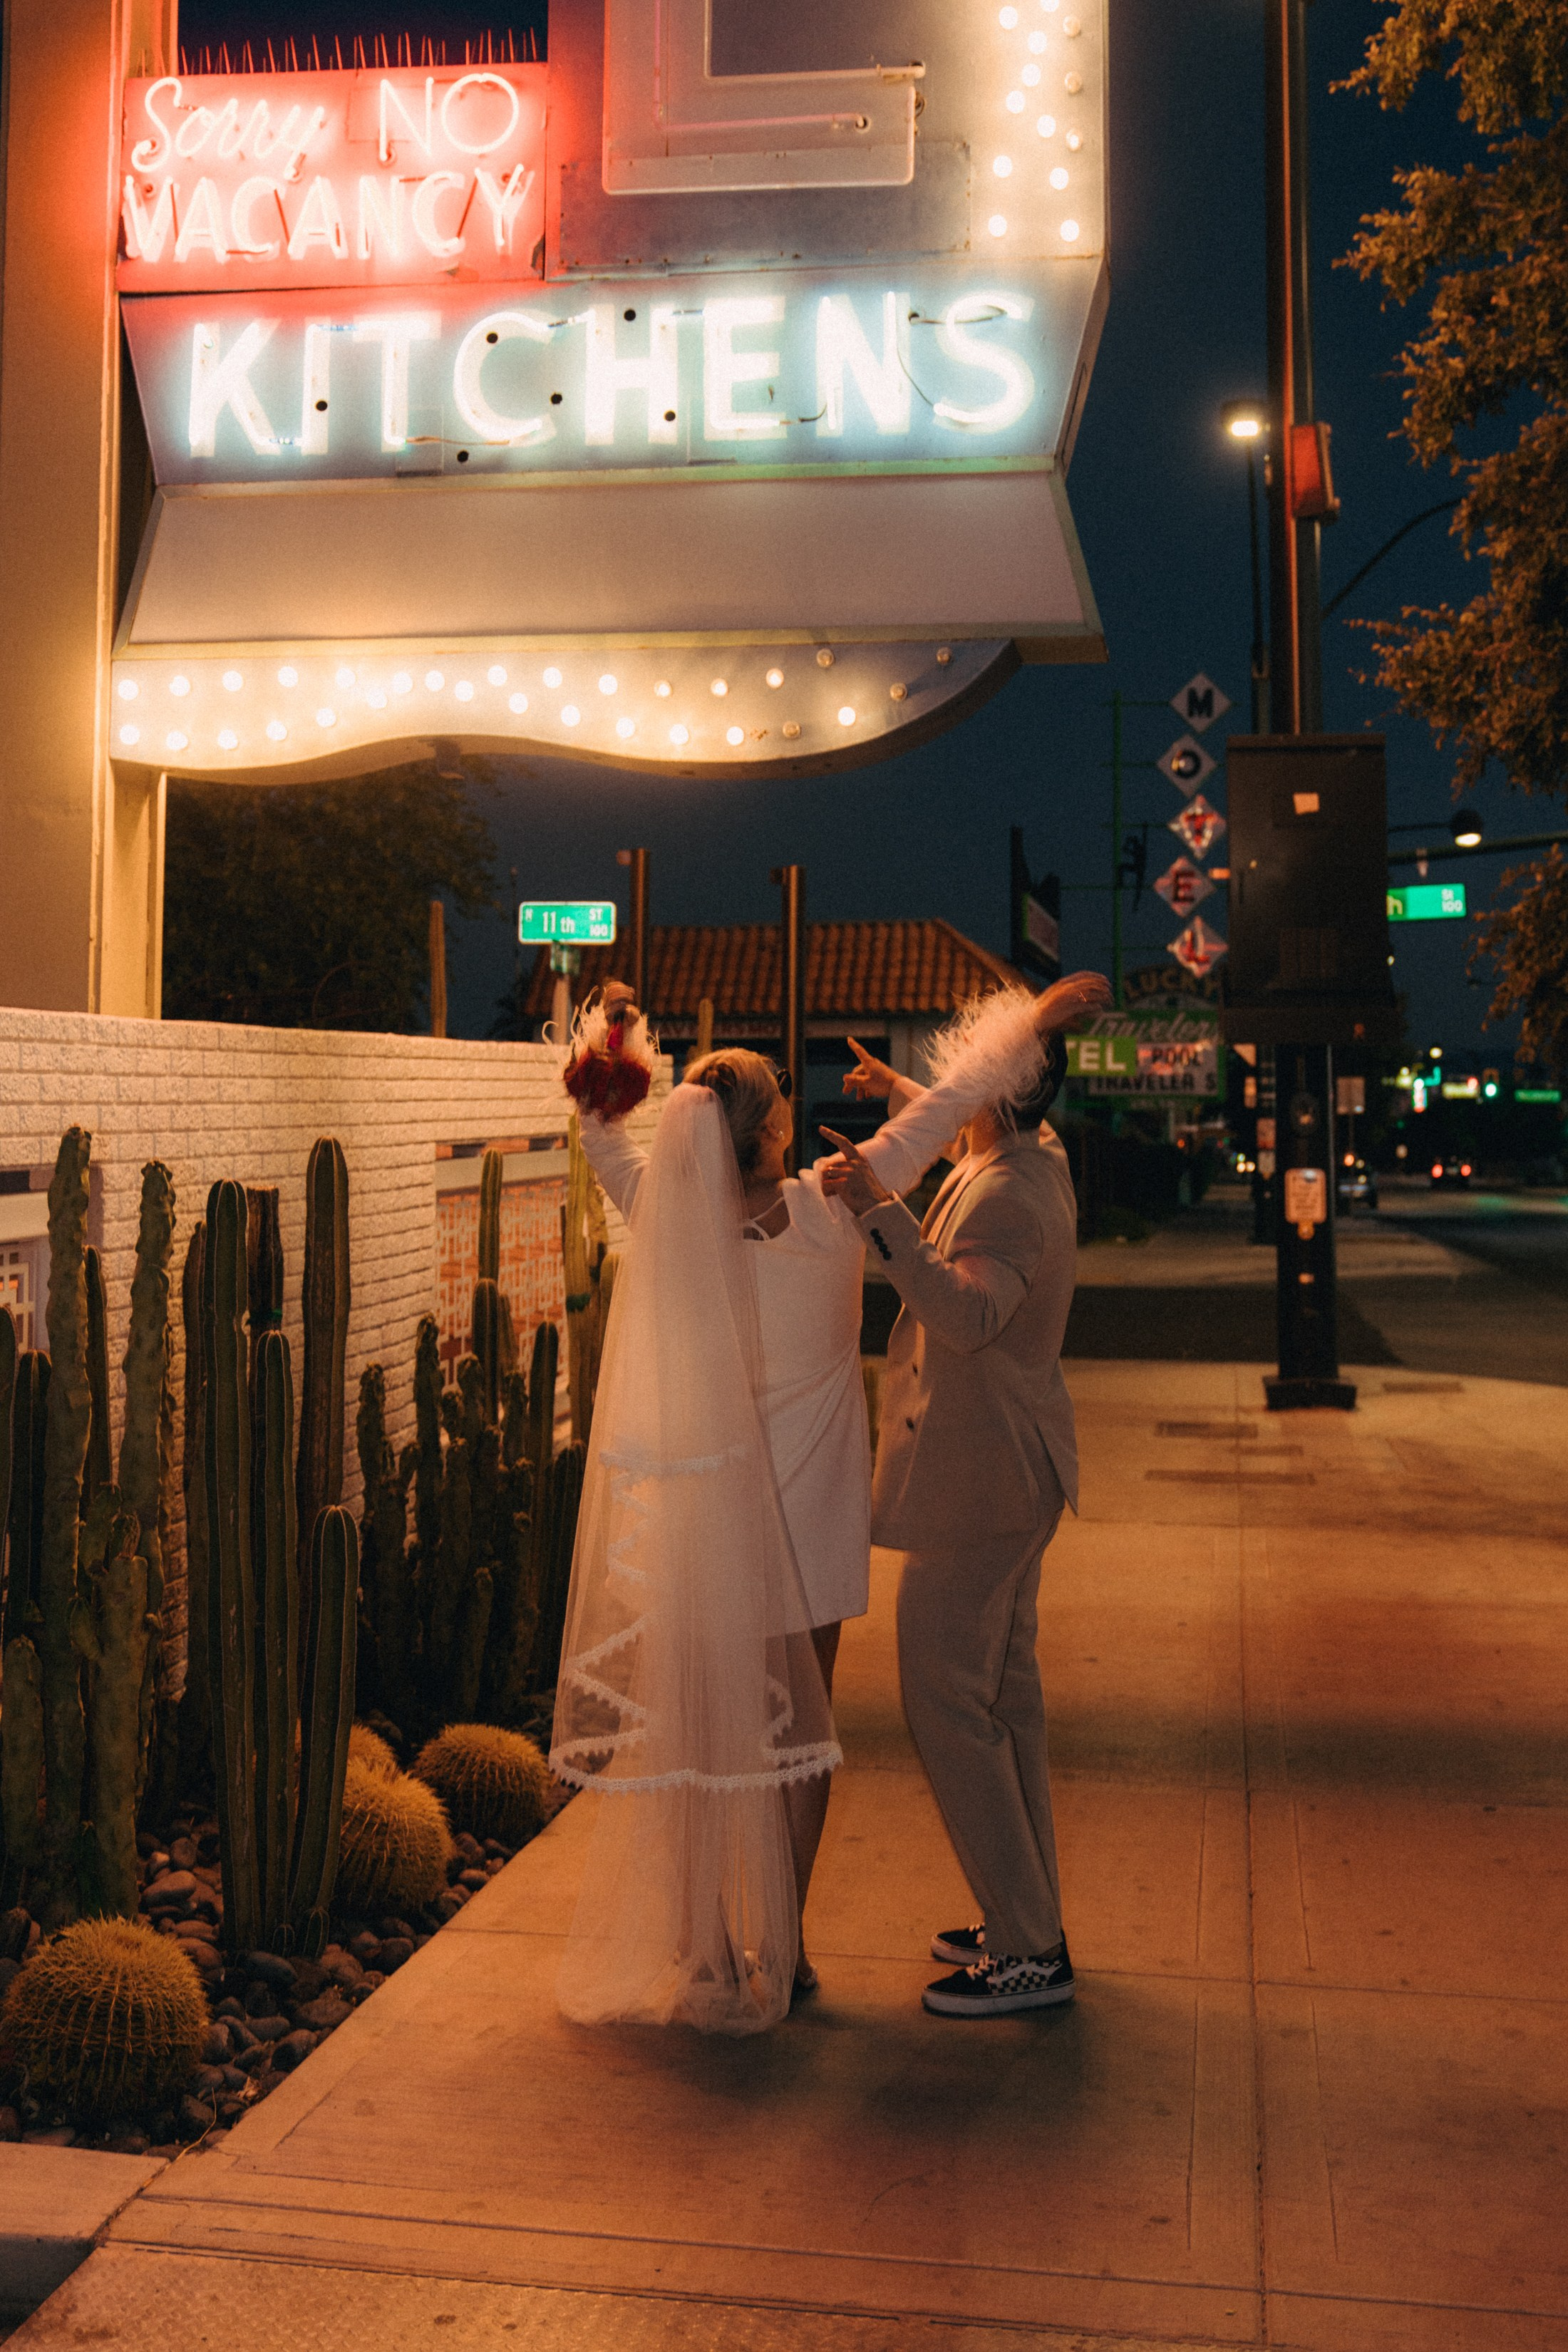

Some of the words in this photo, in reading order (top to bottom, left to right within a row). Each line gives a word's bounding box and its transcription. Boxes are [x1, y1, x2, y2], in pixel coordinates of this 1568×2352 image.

[131, 76, 325, 182] Sorry
[379, 72, 520, 163] NO
[123, 164, 535, 264] VACANCY
[187, 291, 1036, 458] KITCHENS
